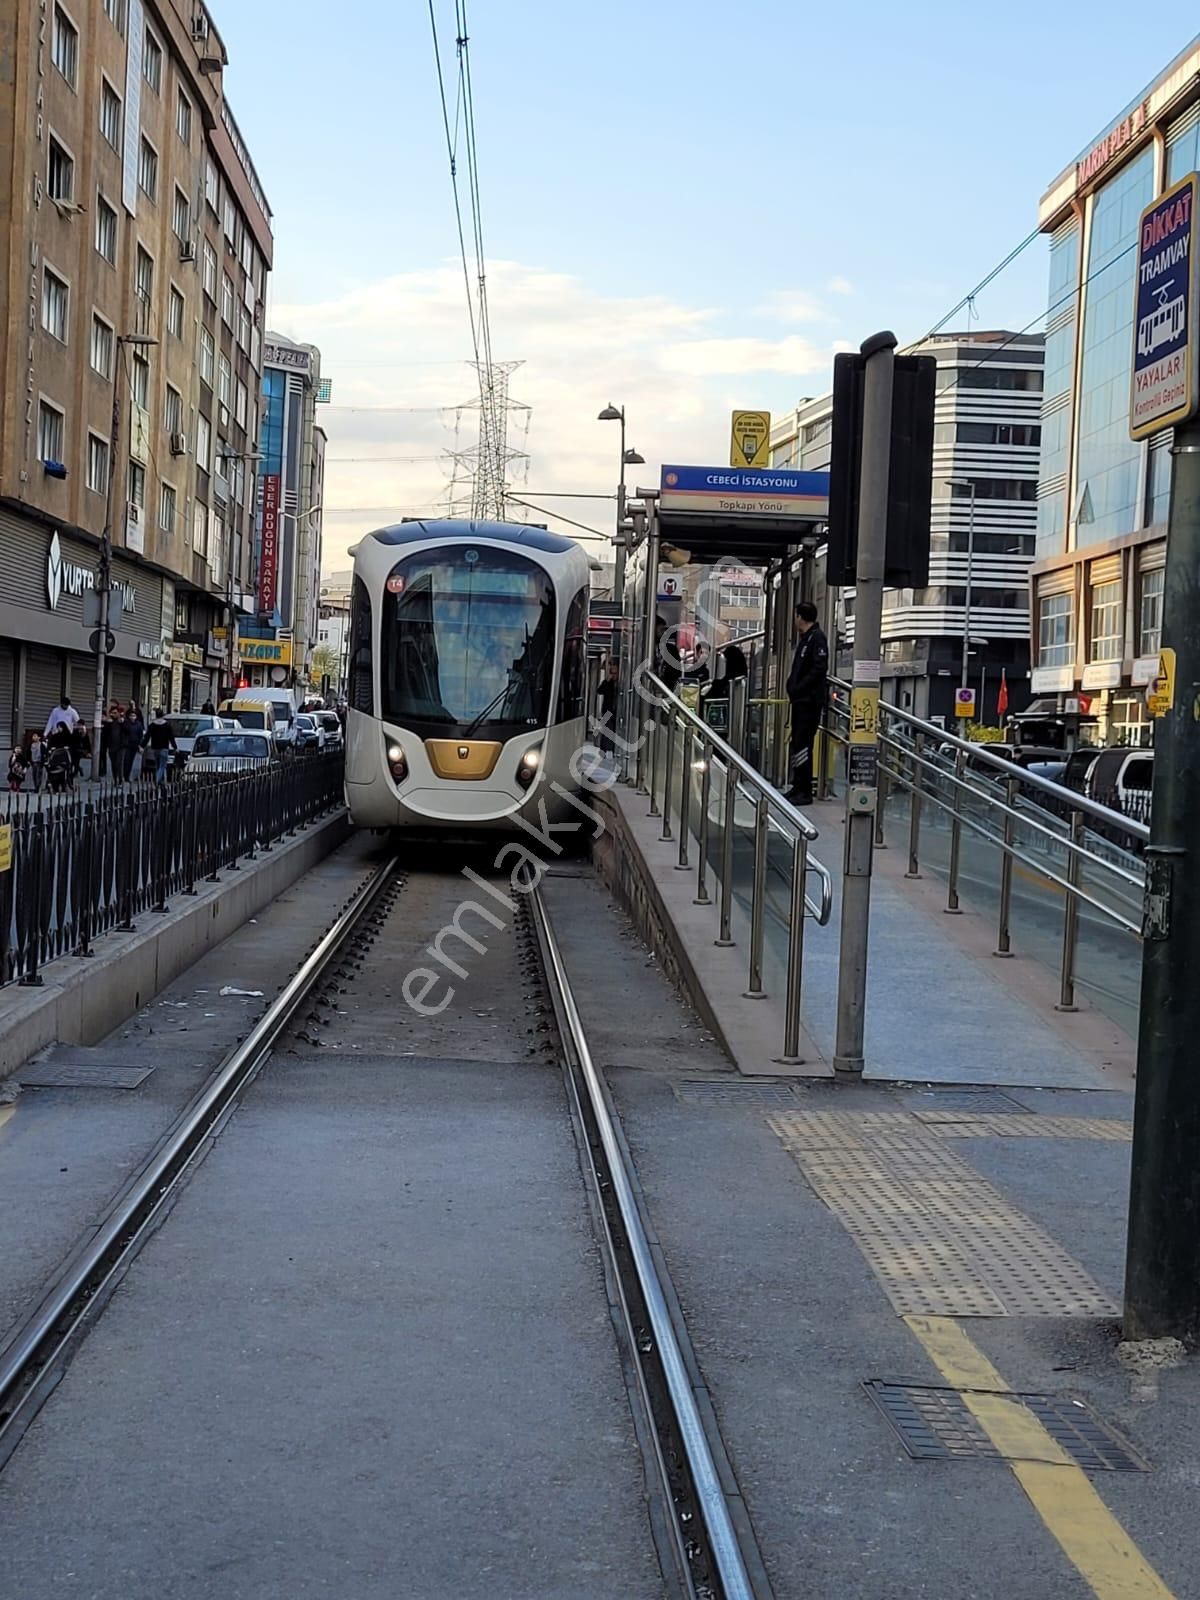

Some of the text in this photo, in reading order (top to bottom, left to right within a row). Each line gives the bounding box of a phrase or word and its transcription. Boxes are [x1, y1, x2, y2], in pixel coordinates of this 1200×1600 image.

[1142, 192, 1192, 252] DİKKAT
[1140, 232, 1191, 285] TRAMVAY
[1136, 356, 1180, 393] YAYALAR
[266, 476, 276, 509] ESER
[706, 474, 798, 488] CEBECİ İSTASYONU
[719, 501, 756, 511] Topkapı
[391, 579, 403, 588] T4
